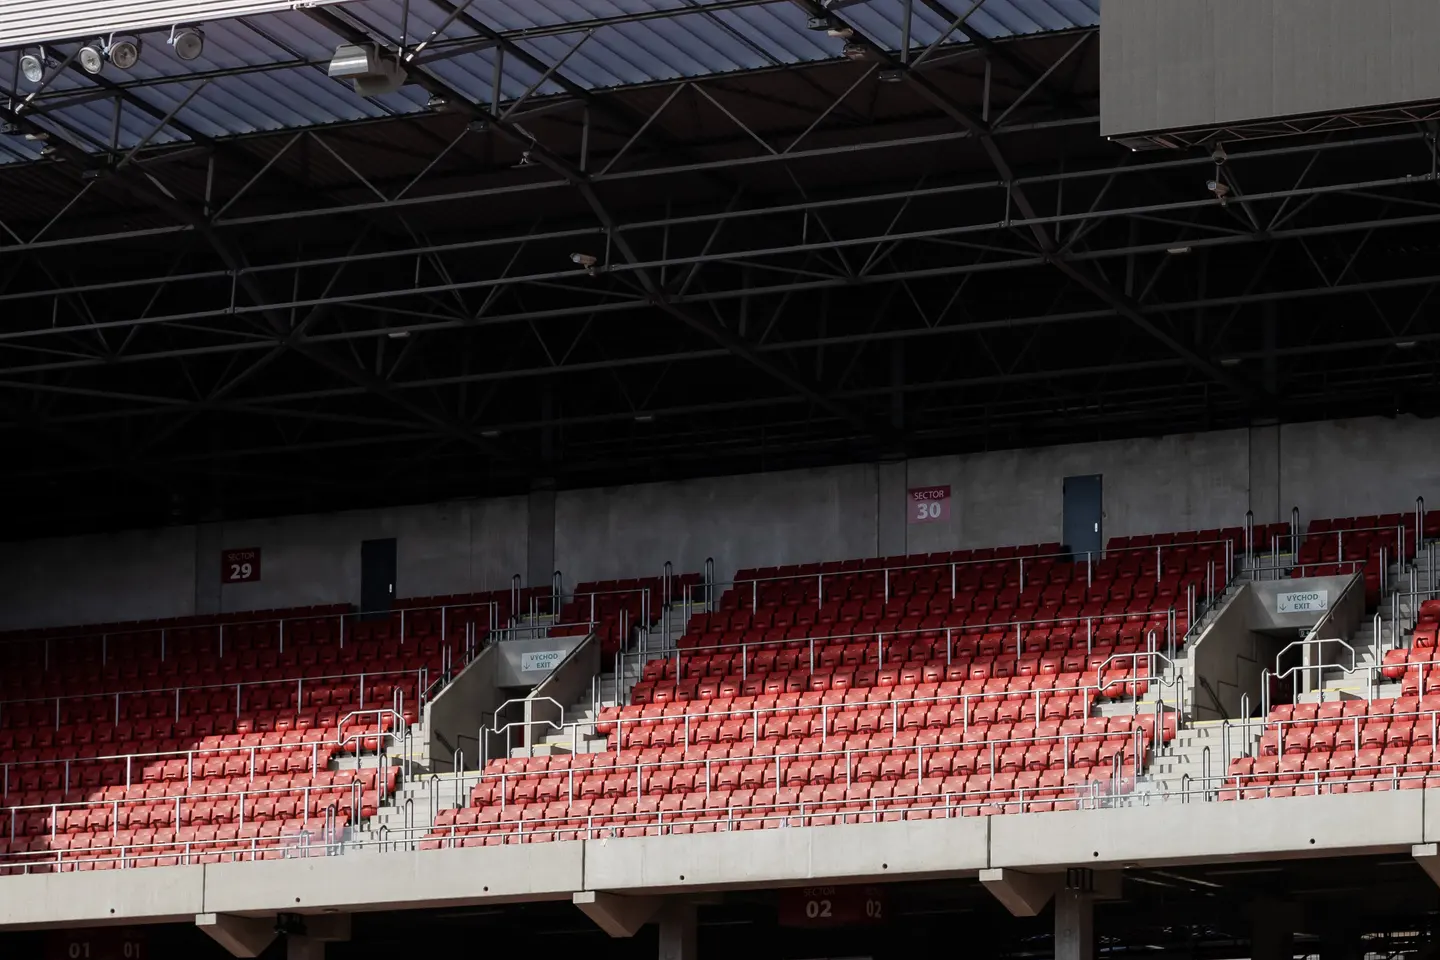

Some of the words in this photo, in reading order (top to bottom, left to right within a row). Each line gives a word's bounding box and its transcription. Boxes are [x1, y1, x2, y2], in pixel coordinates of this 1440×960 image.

[914, 490, 944, 500] SECTOR
[917, 502, 941, 519] 30
[227, 551, 255, 561] SECTOR
[230, 563, 252, 579] 29
[1287, 593, 1319, 601] VÝCHOD
[806, 900, 832, 918] 02
[866, 899, 882, 918] 02
[68, 941, 90, 959] 01
[123, 941, 140, 959] 01
